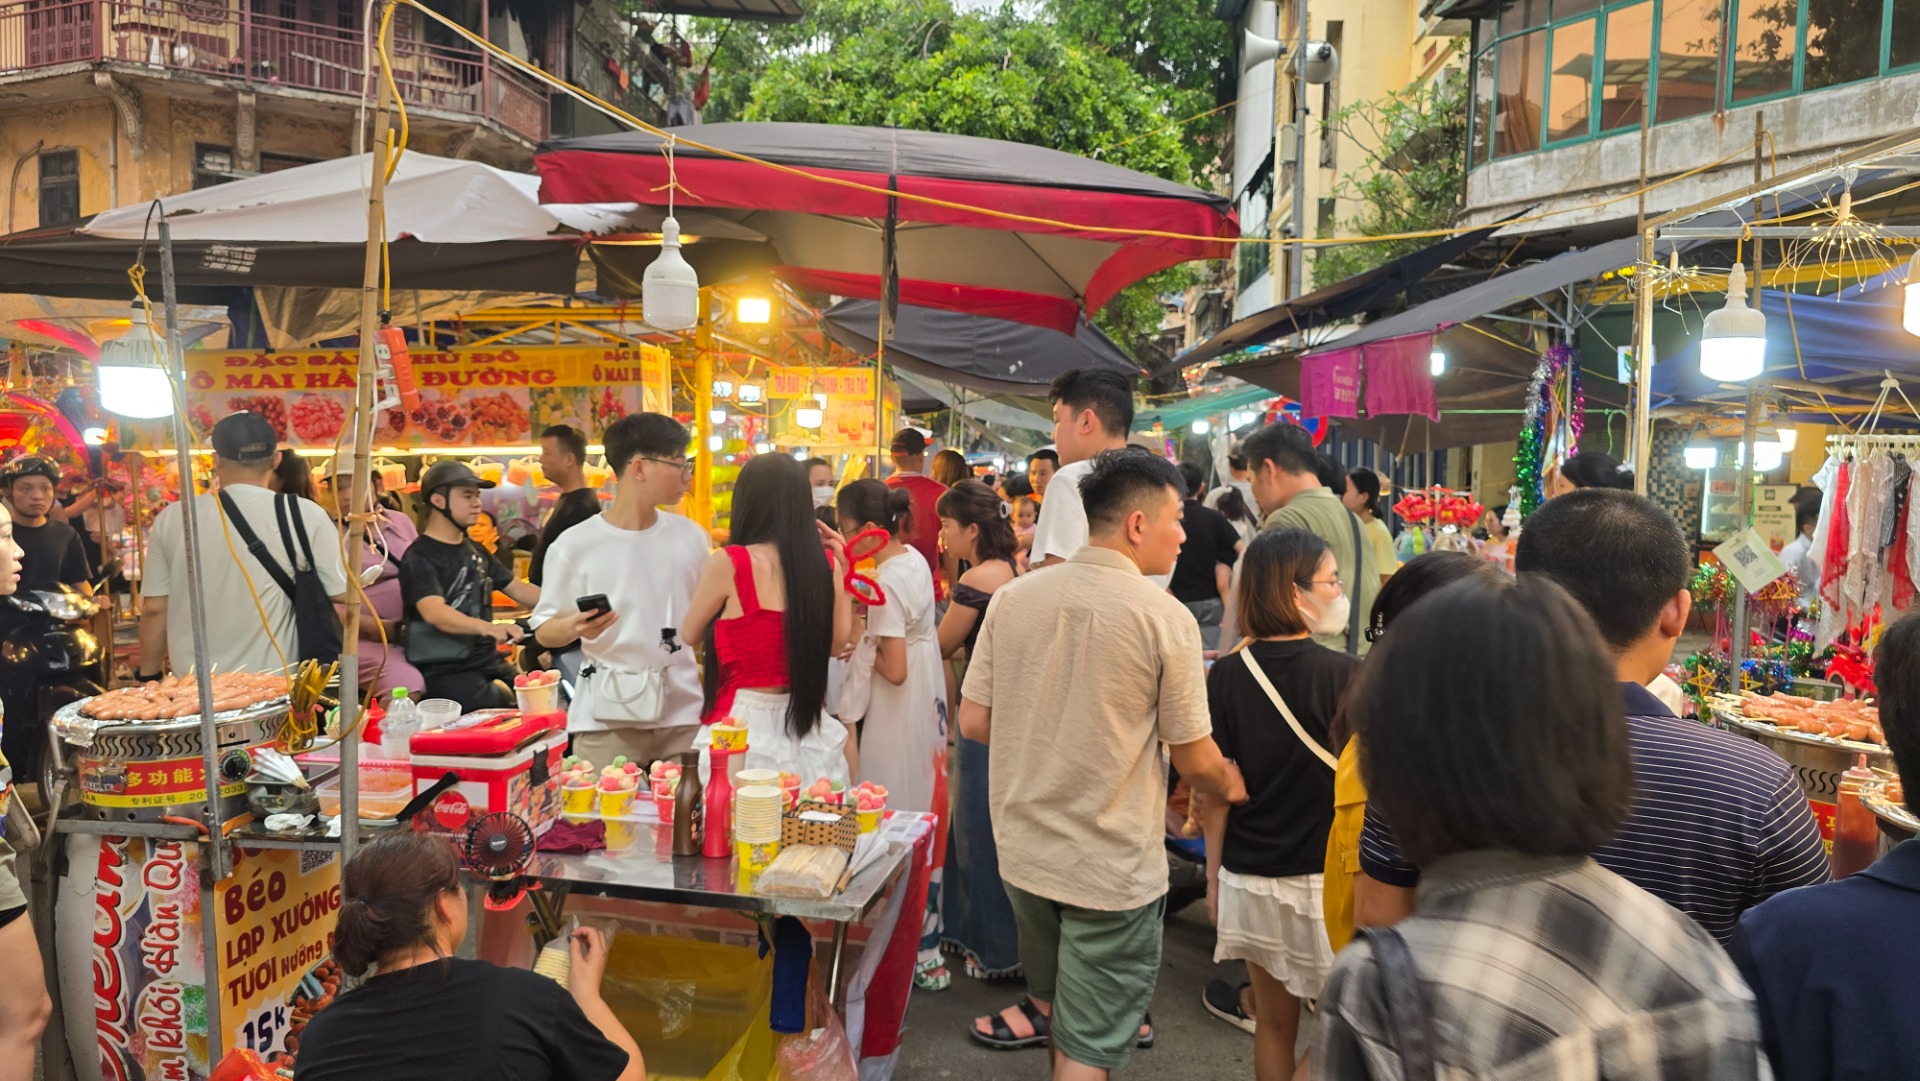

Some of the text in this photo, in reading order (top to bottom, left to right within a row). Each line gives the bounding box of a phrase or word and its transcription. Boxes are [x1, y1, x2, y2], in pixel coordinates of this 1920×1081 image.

[224, 353, 298, 368] ĐẶC
[411, 350, 460, 364] HỦ
[471, 350, 520, 363] ĐÔ
[225, 373, 296, 389] MAI
[421, 366, 557, 387] ĐƯỜNG
[604, 367, 629, 382] MAI
[143, 841, 184, 891] Qu
[224, 867, 287, 926] Béo
[144, 903, 180, 974] Hàn
[226, 883, 341, 970] LẠP XƯỞNG
[228, 955, 277, 1008] TƯƠI
